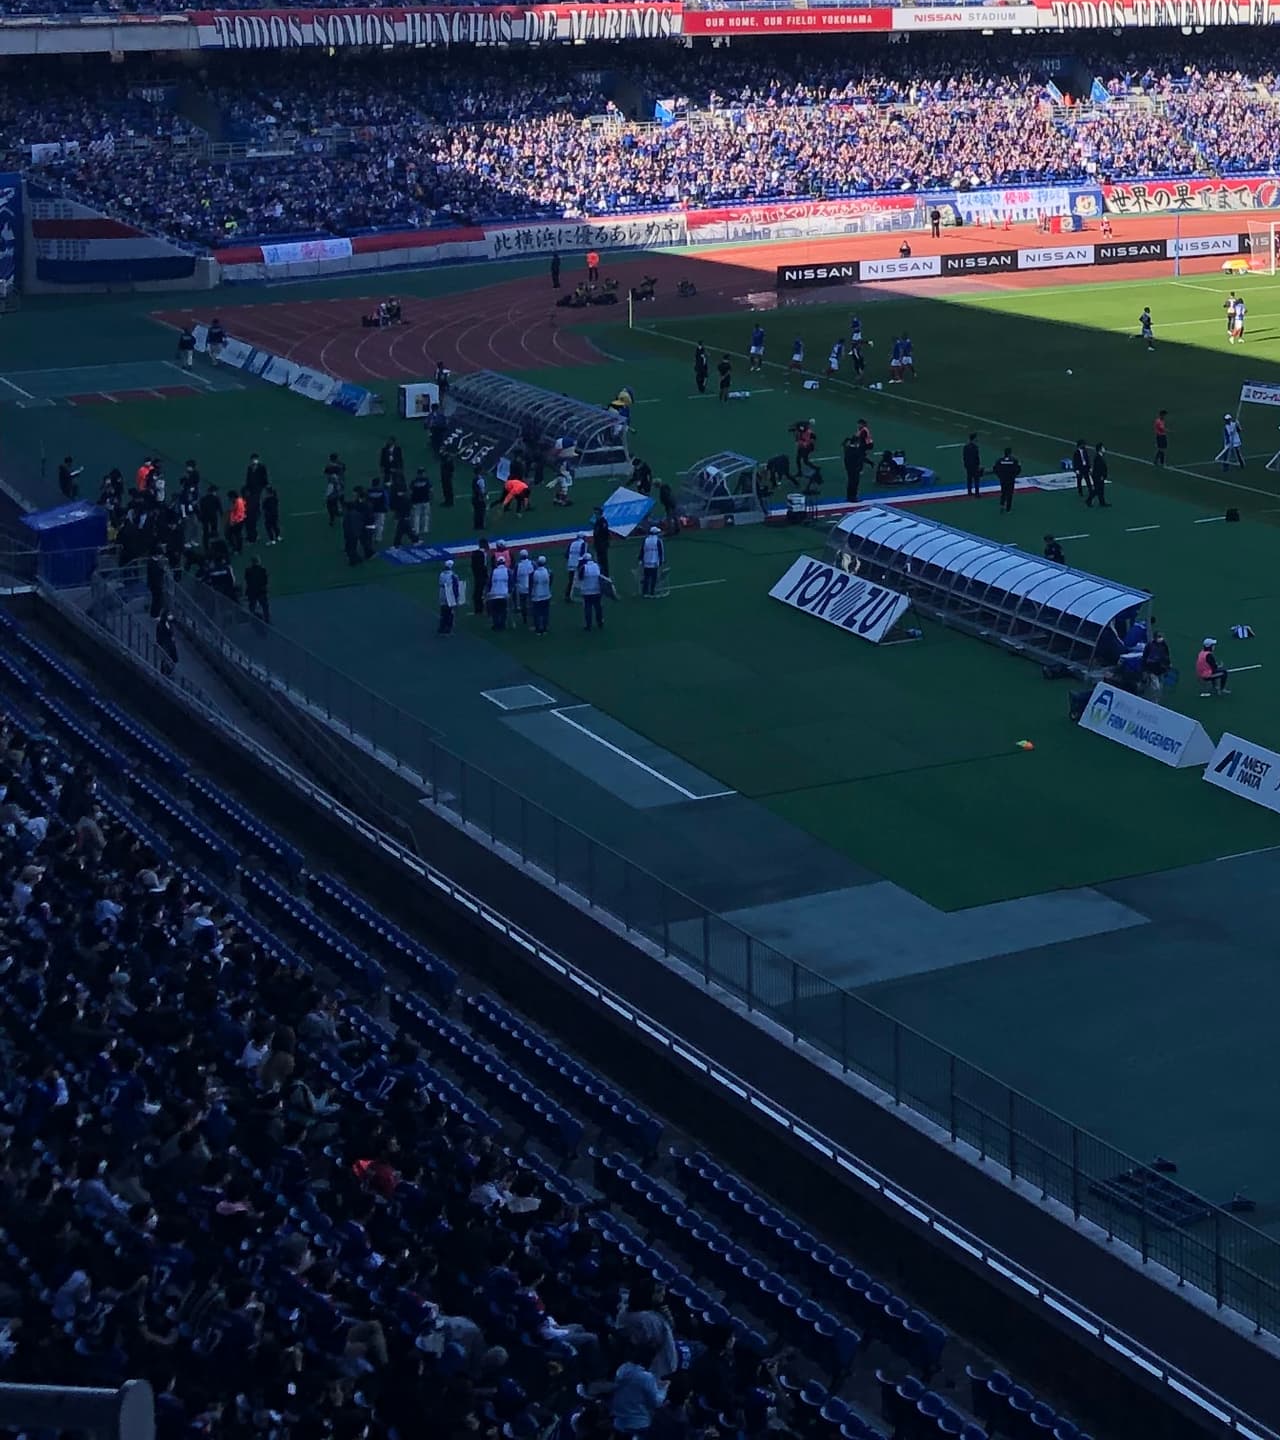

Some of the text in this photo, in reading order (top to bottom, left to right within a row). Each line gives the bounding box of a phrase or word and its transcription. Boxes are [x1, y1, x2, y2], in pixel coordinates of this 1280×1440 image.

[705, 17, 726, 28] OUR
[764, 16, 783, 27] OUR
[821, 14, 873, 25] YOKOHAMA
[913, 11, 1017, 23] NISSAN STADIUM
[1051, 0, 1126, 28] TODOS
[214, 7, 673, 48] TODOS SOMOS HINCHAS DE MARINOS
[1100, 244, 1161, 259] NISSAN
[1174, 238, 1232, 253] NISSAN
[947, 255, 1012, 269] NISSAN
[1025, 250, 1087, 263] NISSAN
[785, 266, 853, 281] NISSAN
[867, 261, 933, 275] NISSAN
[1107, 713, 1127, 731] FIRM
[1125, 722, 1183, 755] MANAGEMENT
[1240, 752, 1272, 777] ANEST
[1237, 770, 1262, 791] IWATA
